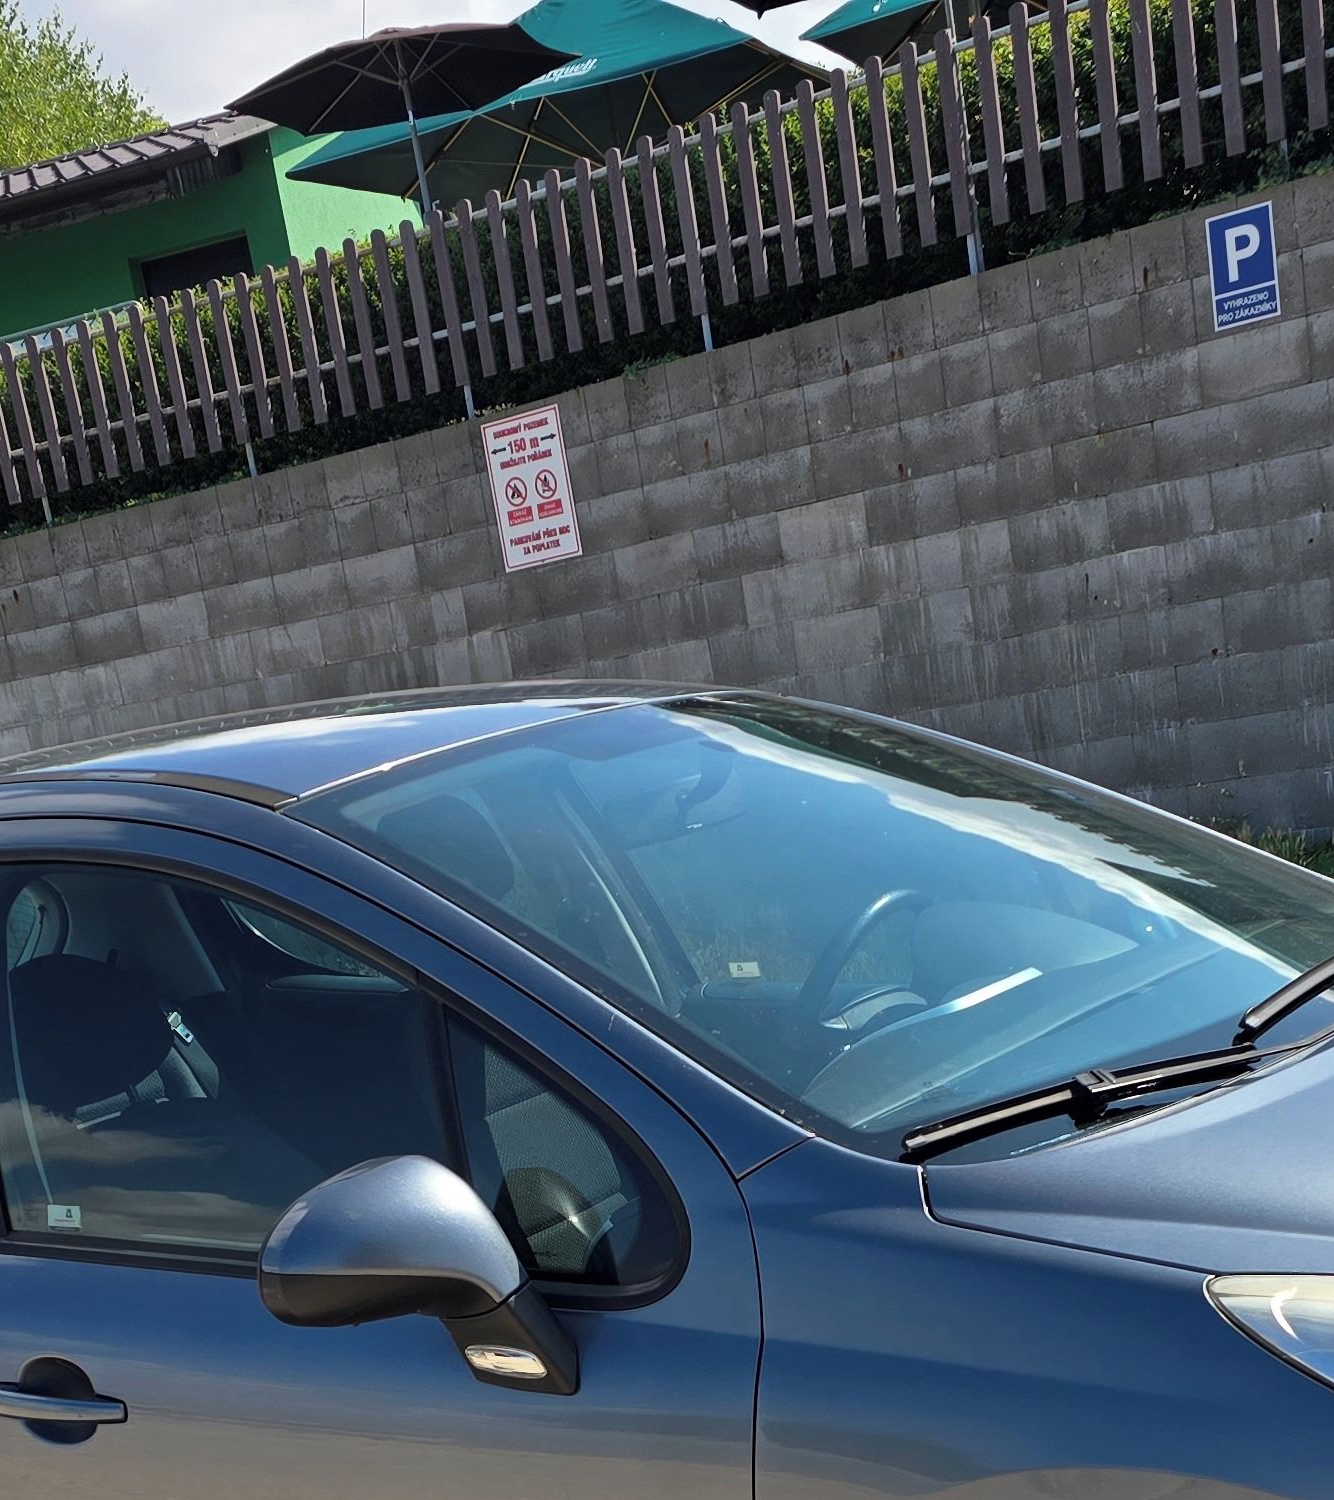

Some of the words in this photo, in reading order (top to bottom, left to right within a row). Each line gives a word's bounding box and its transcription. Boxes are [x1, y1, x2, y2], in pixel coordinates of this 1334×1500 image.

[1225, 224, 1260, 283] P
[1223, 291, 1269, 310] VYHRAZENO
[1218, 312, 1234, 324] PRO
[508, 437, 527, 454] 150
[529, 437, 539, 449] m
